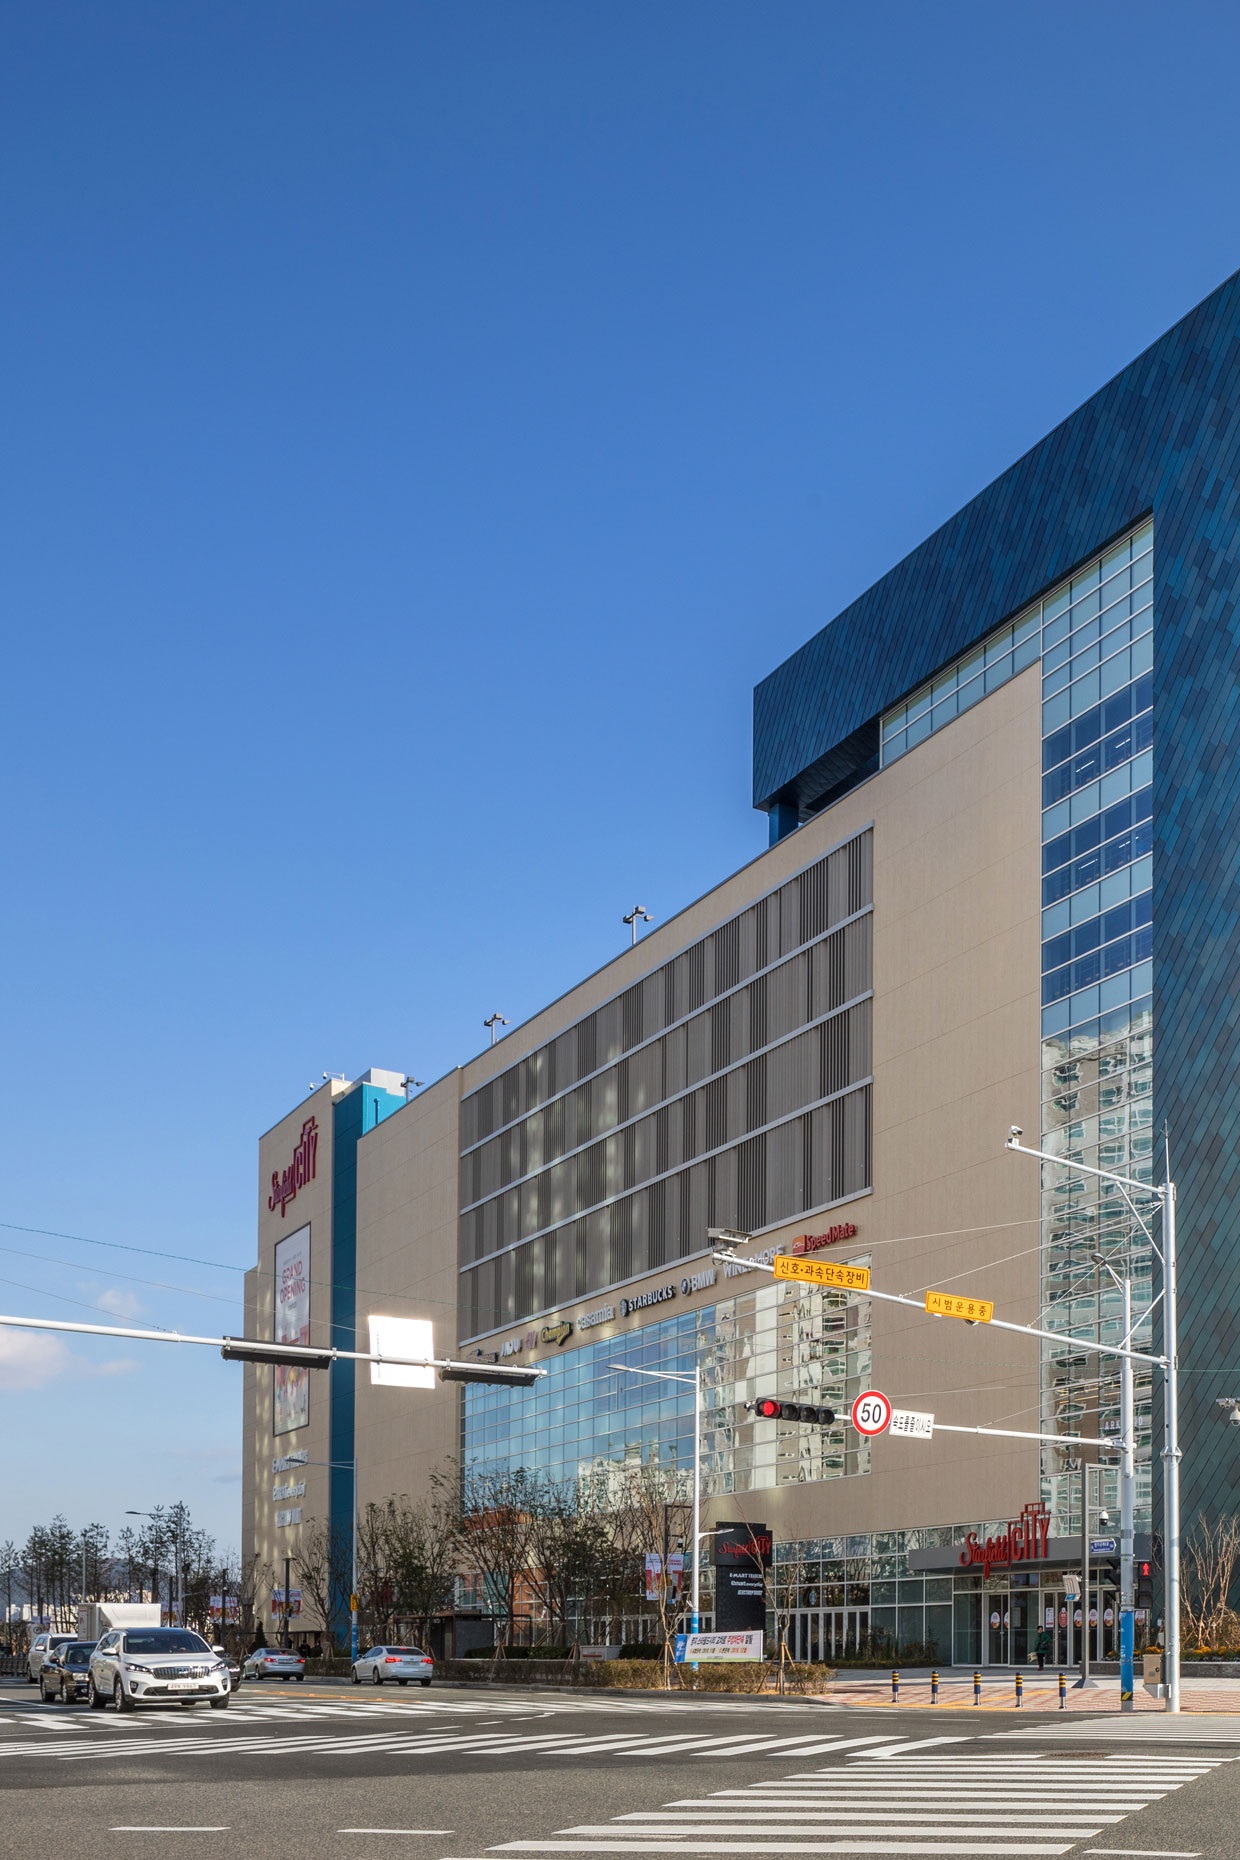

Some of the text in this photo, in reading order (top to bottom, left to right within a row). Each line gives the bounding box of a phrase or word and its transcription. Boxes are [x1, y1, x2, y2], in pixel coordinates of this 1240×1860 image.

[804, 1222, 857, 1253] SpeedMate
[282, 1260, 303, 1285] GRAND
[691, 1269, 717, 1292] BMW
[280, 1277, 306, 1304] OPENING
[628, 1285, 674, 1312] STARBUCKS
[577, 1304, 615, 1330] casamia
[861, 1403, 882, 1424] 50
[960, 1509, 1051, 1580] Starfield CITY
